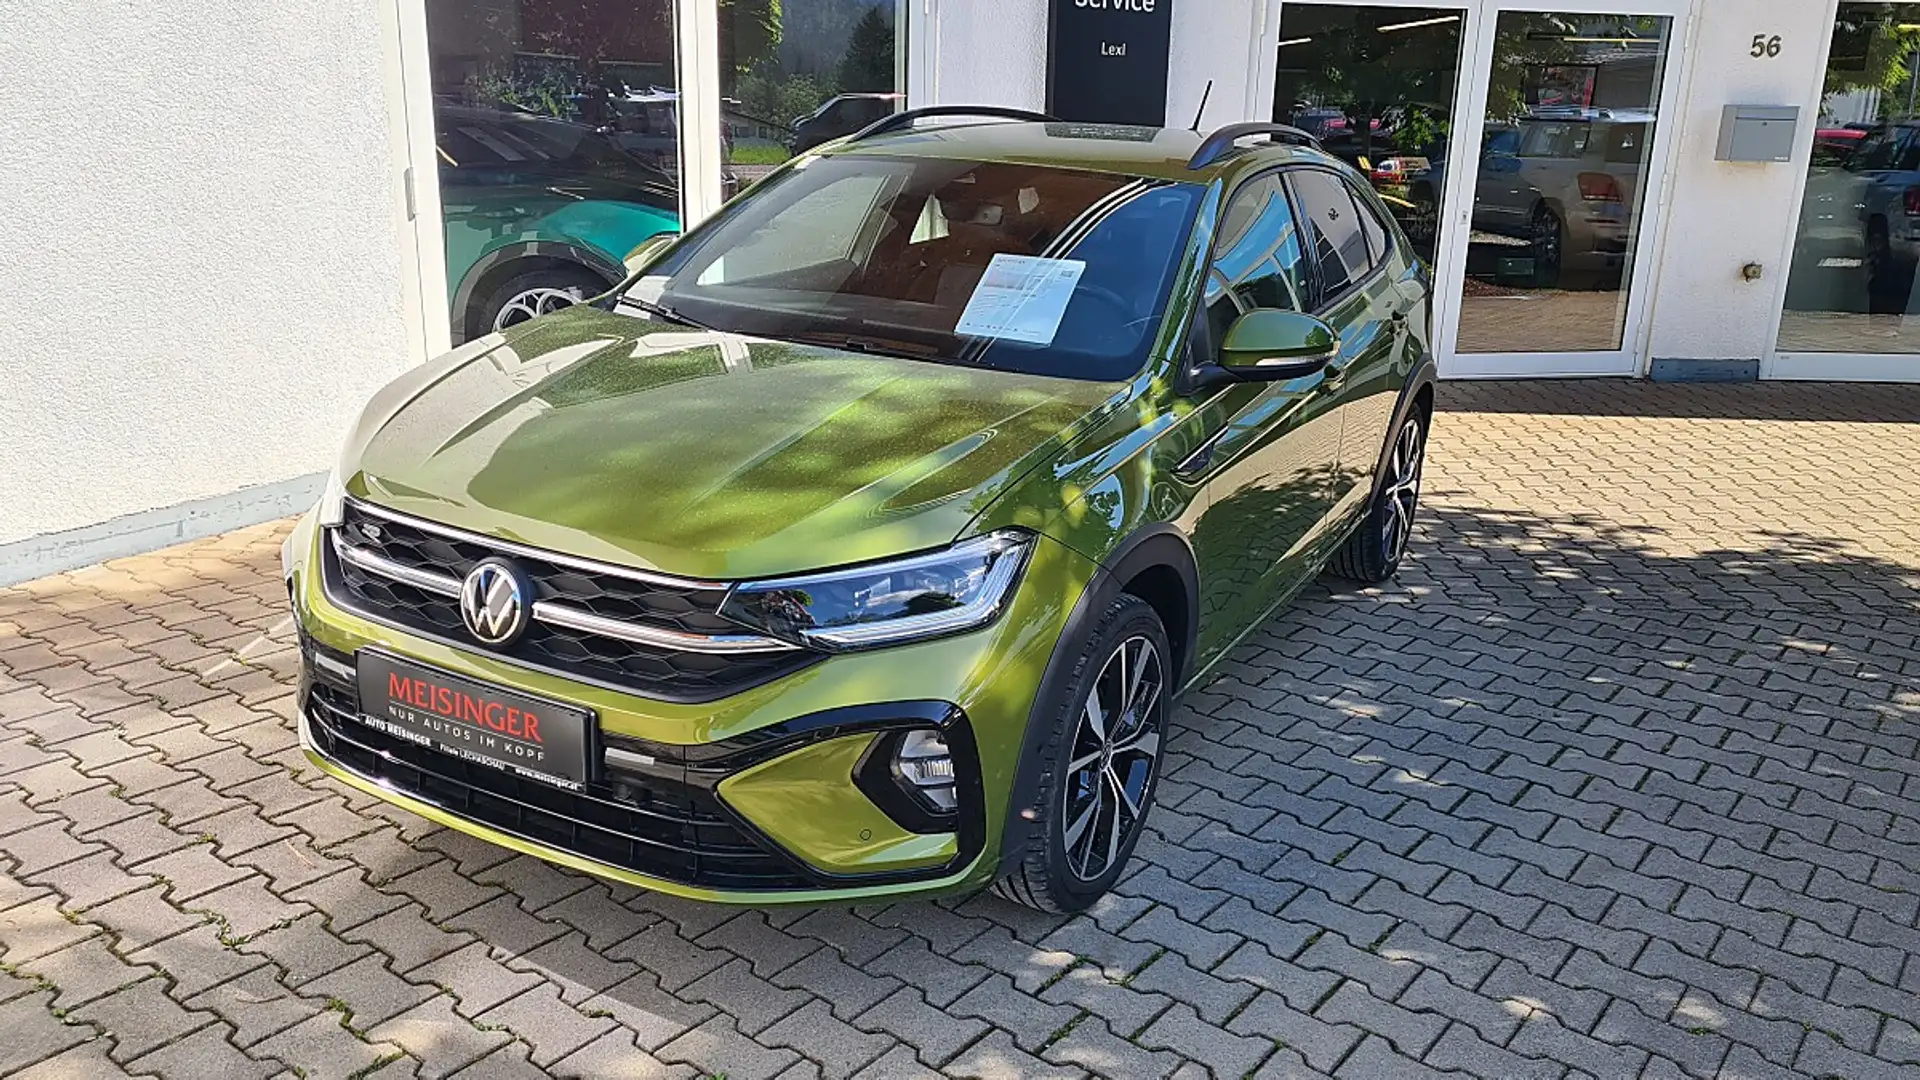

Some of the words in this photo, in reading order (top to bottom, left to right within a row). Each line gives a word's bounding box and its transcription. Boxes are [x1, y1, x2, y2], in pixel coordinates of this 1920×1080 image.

[1101, 42, 1126, 56] Lexl
[1750, 34, 1782, 58] 56
[388, 672, 543, 743] MEISINGER
[365, 715, 386, 731] AUTO
[387, 723, 432, 747] MEISINGER
[388, 706, 415, 723] NUR
[423, 718, 471, 741] AUTOS
[480, 735, 495, 748] IM
[504, 743, 545, 761] KOPF
